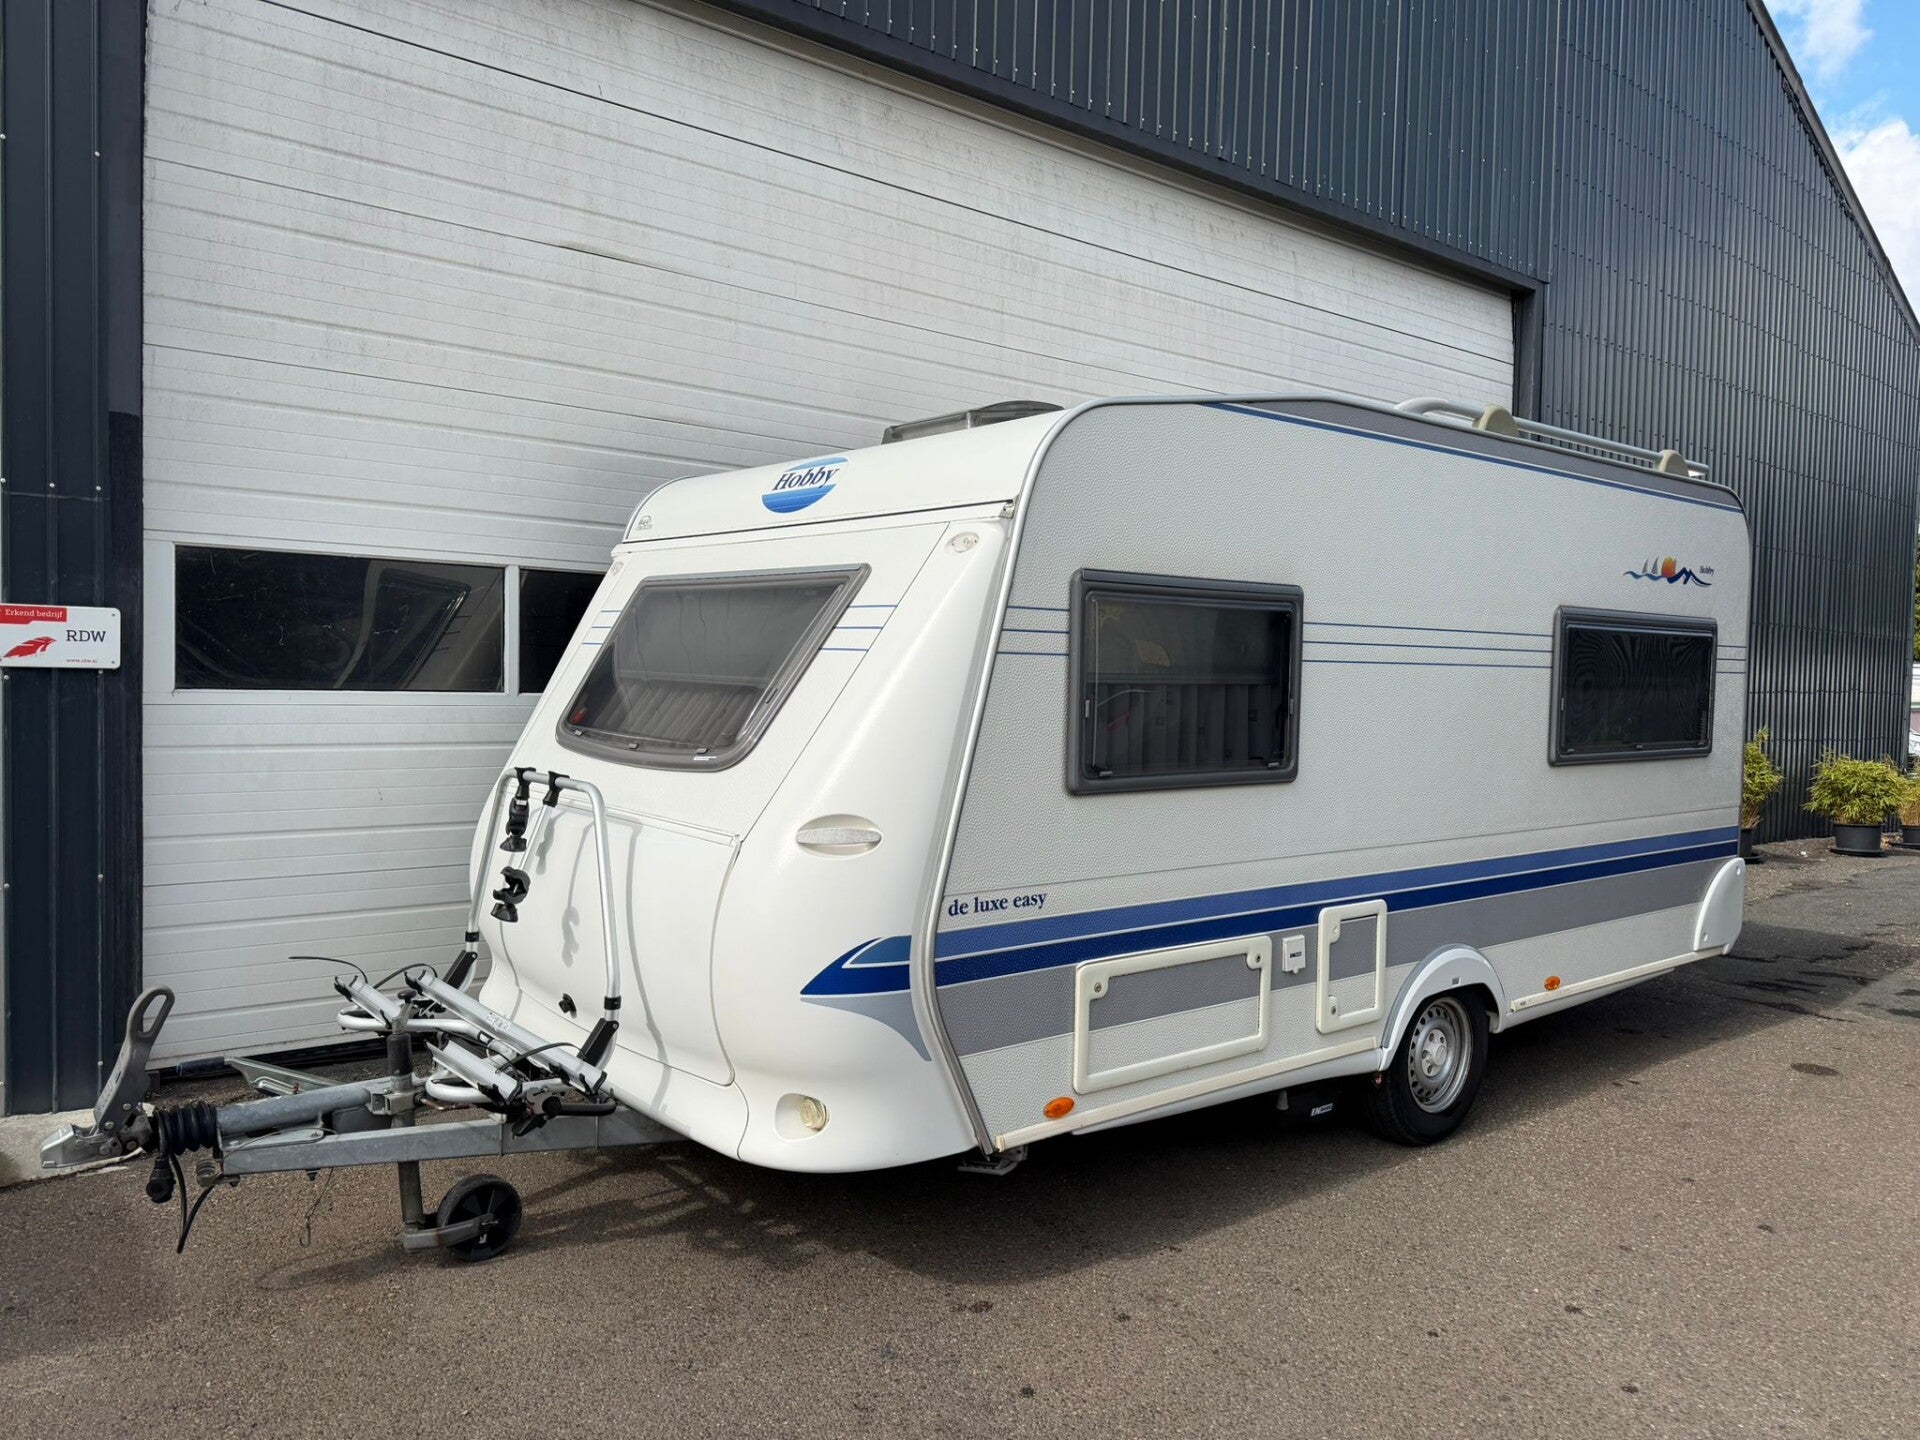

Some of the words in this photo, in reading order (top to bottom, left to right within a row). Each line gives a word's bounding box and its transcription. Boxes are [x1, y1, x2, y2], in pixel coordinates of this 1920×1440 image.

[772, 466, 840, 491] Hobby
[5, 608, 35, 617] Erkend
[36, 610, 63, 618] bedrijf
[66, 629, 107, 643] RDW
[948, 899, 969, 916] de
[973, 896, 1009, 913] luxe
[1013, 893, 1047, 909] easy
